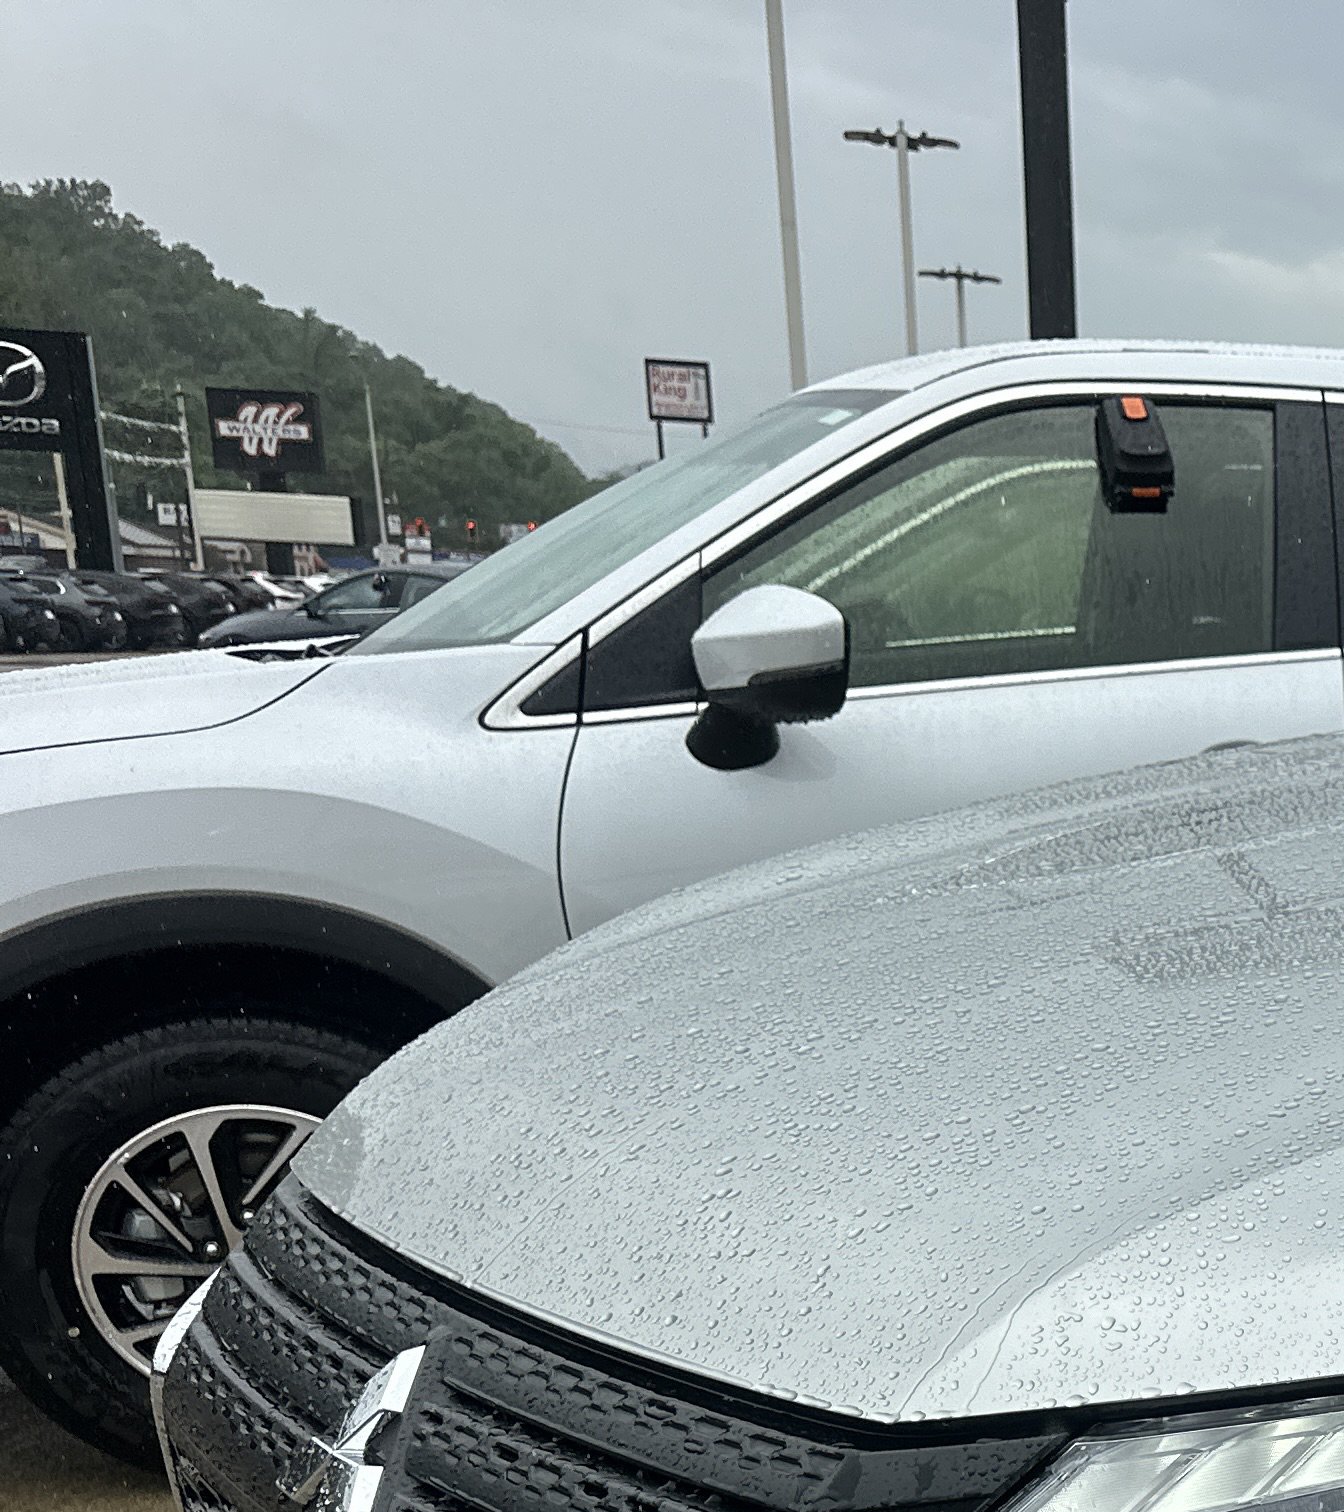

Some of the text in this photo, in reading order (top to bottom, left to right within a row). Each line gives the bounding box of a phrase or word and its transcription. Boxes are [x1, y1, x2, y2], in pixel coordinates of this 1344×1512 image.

[651, 367, 690, 382] Rural
[652, 382, 688, 400] King
[227, 424, 302, 437] WALTERS
